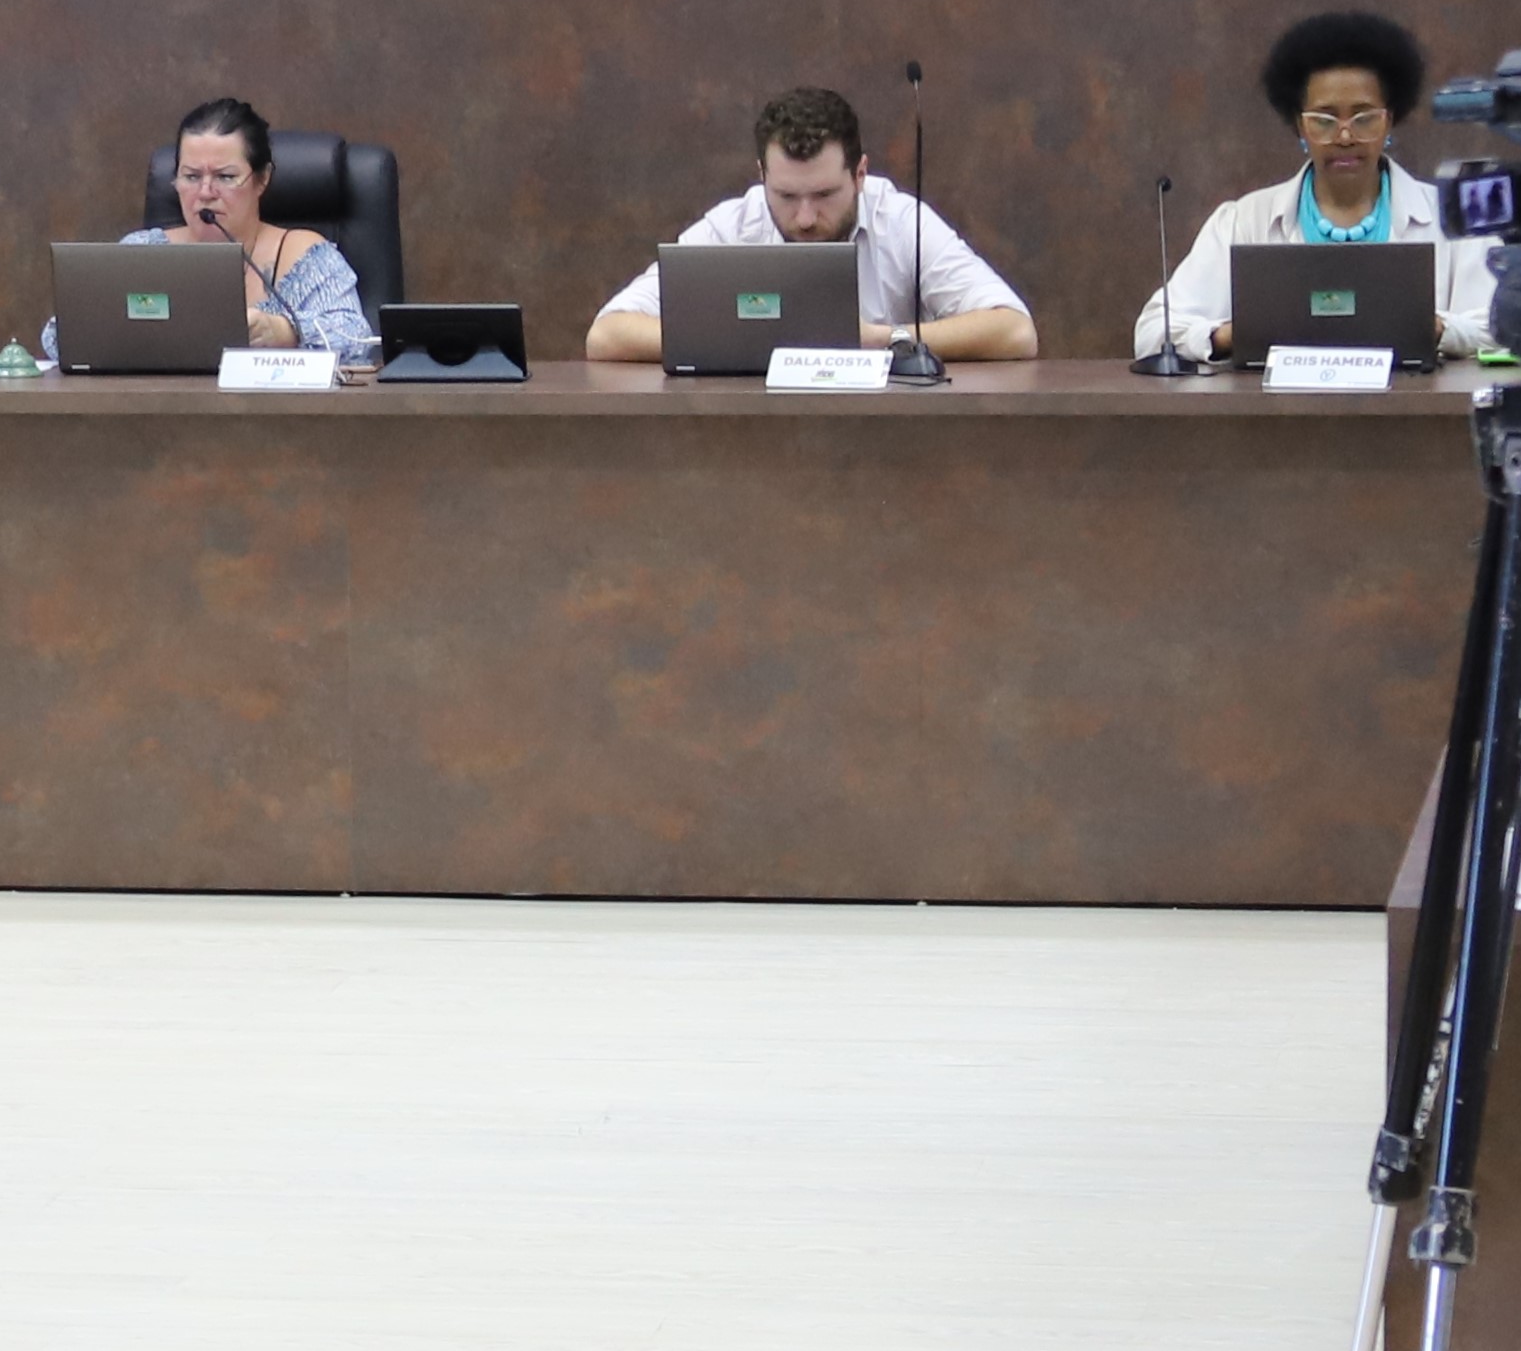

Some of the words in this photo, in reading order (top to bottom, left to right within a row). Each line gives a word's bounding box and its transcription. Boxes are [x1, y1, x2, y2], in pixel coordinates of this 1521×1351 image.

[253, 357, 305, 367] THANIA
[783, 356, 821, 366] DALA
[825, 357, 872, 367] COSTA
[1283, 356, 1317, 366] CRIS
[1320, 356, 1384, 367] HAMERA
